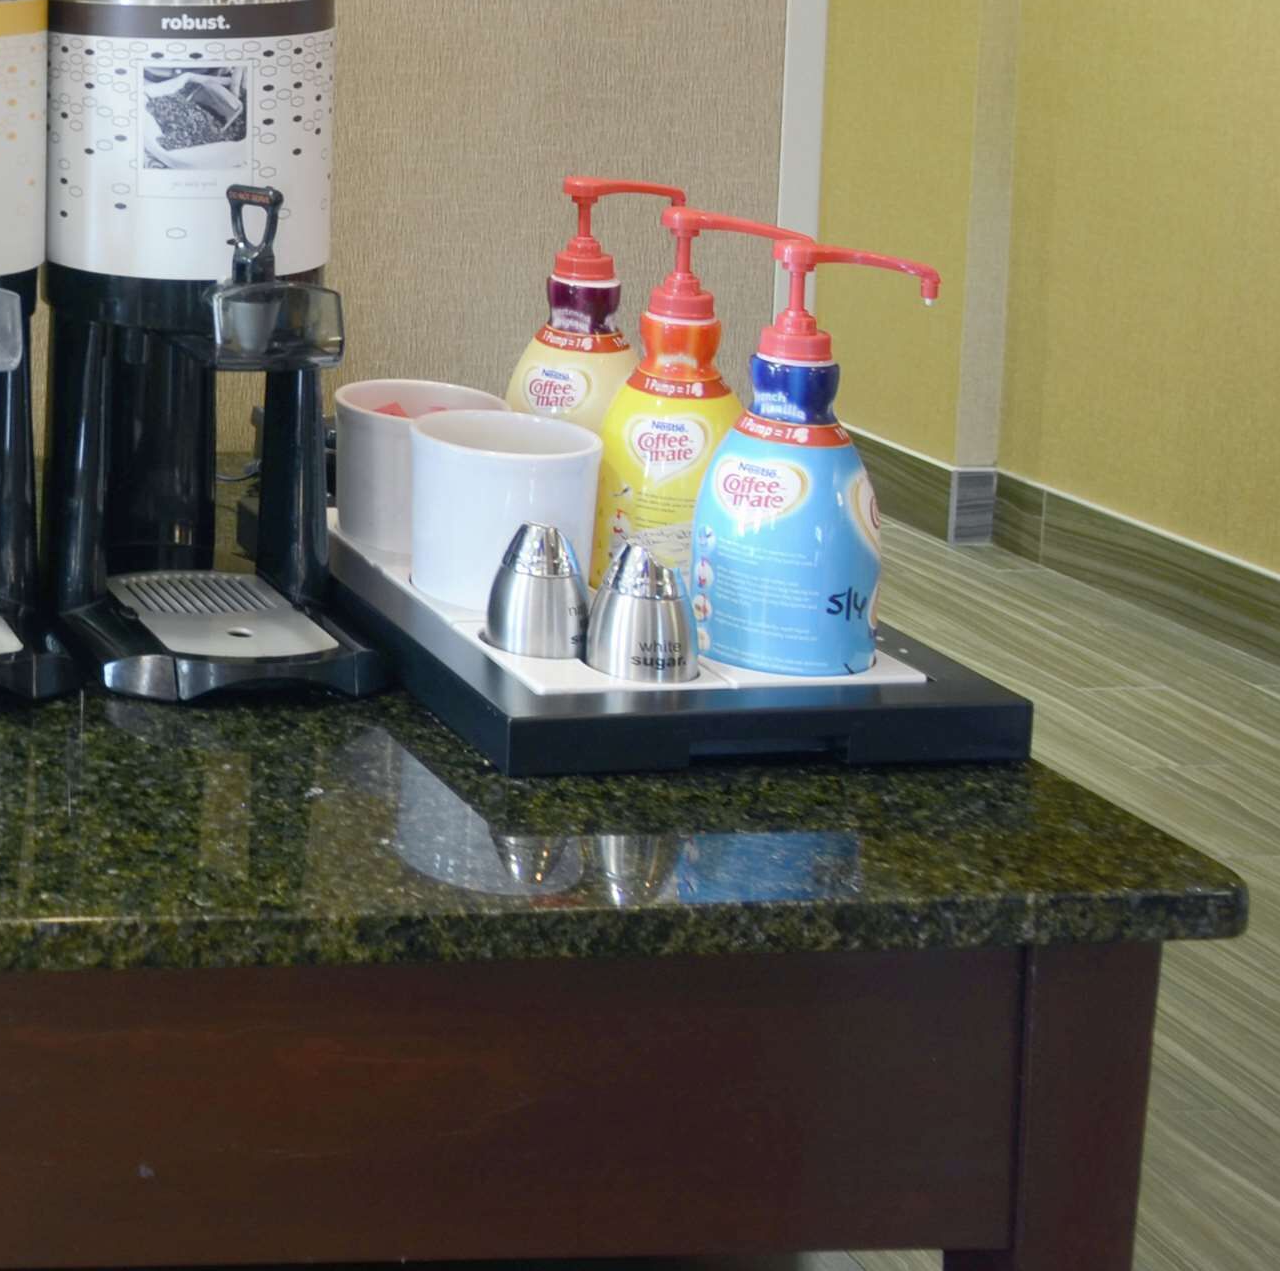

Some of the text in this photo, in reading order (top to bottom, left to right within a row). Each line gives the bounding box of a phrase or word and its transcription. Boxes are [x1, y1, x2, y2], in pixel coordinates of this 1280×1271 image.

[161, 13, 231, 30] robust.
[650, 378, 675, 395] Pump
[536, 395, 574, 407] mate
[745, 418, 773, 438] Pump
[649, 448, 693, 462] mate
[732, 493, 784, 508] mate
[639, 640, 682, 653] white
[631, 656, 687, 670] sugar.
